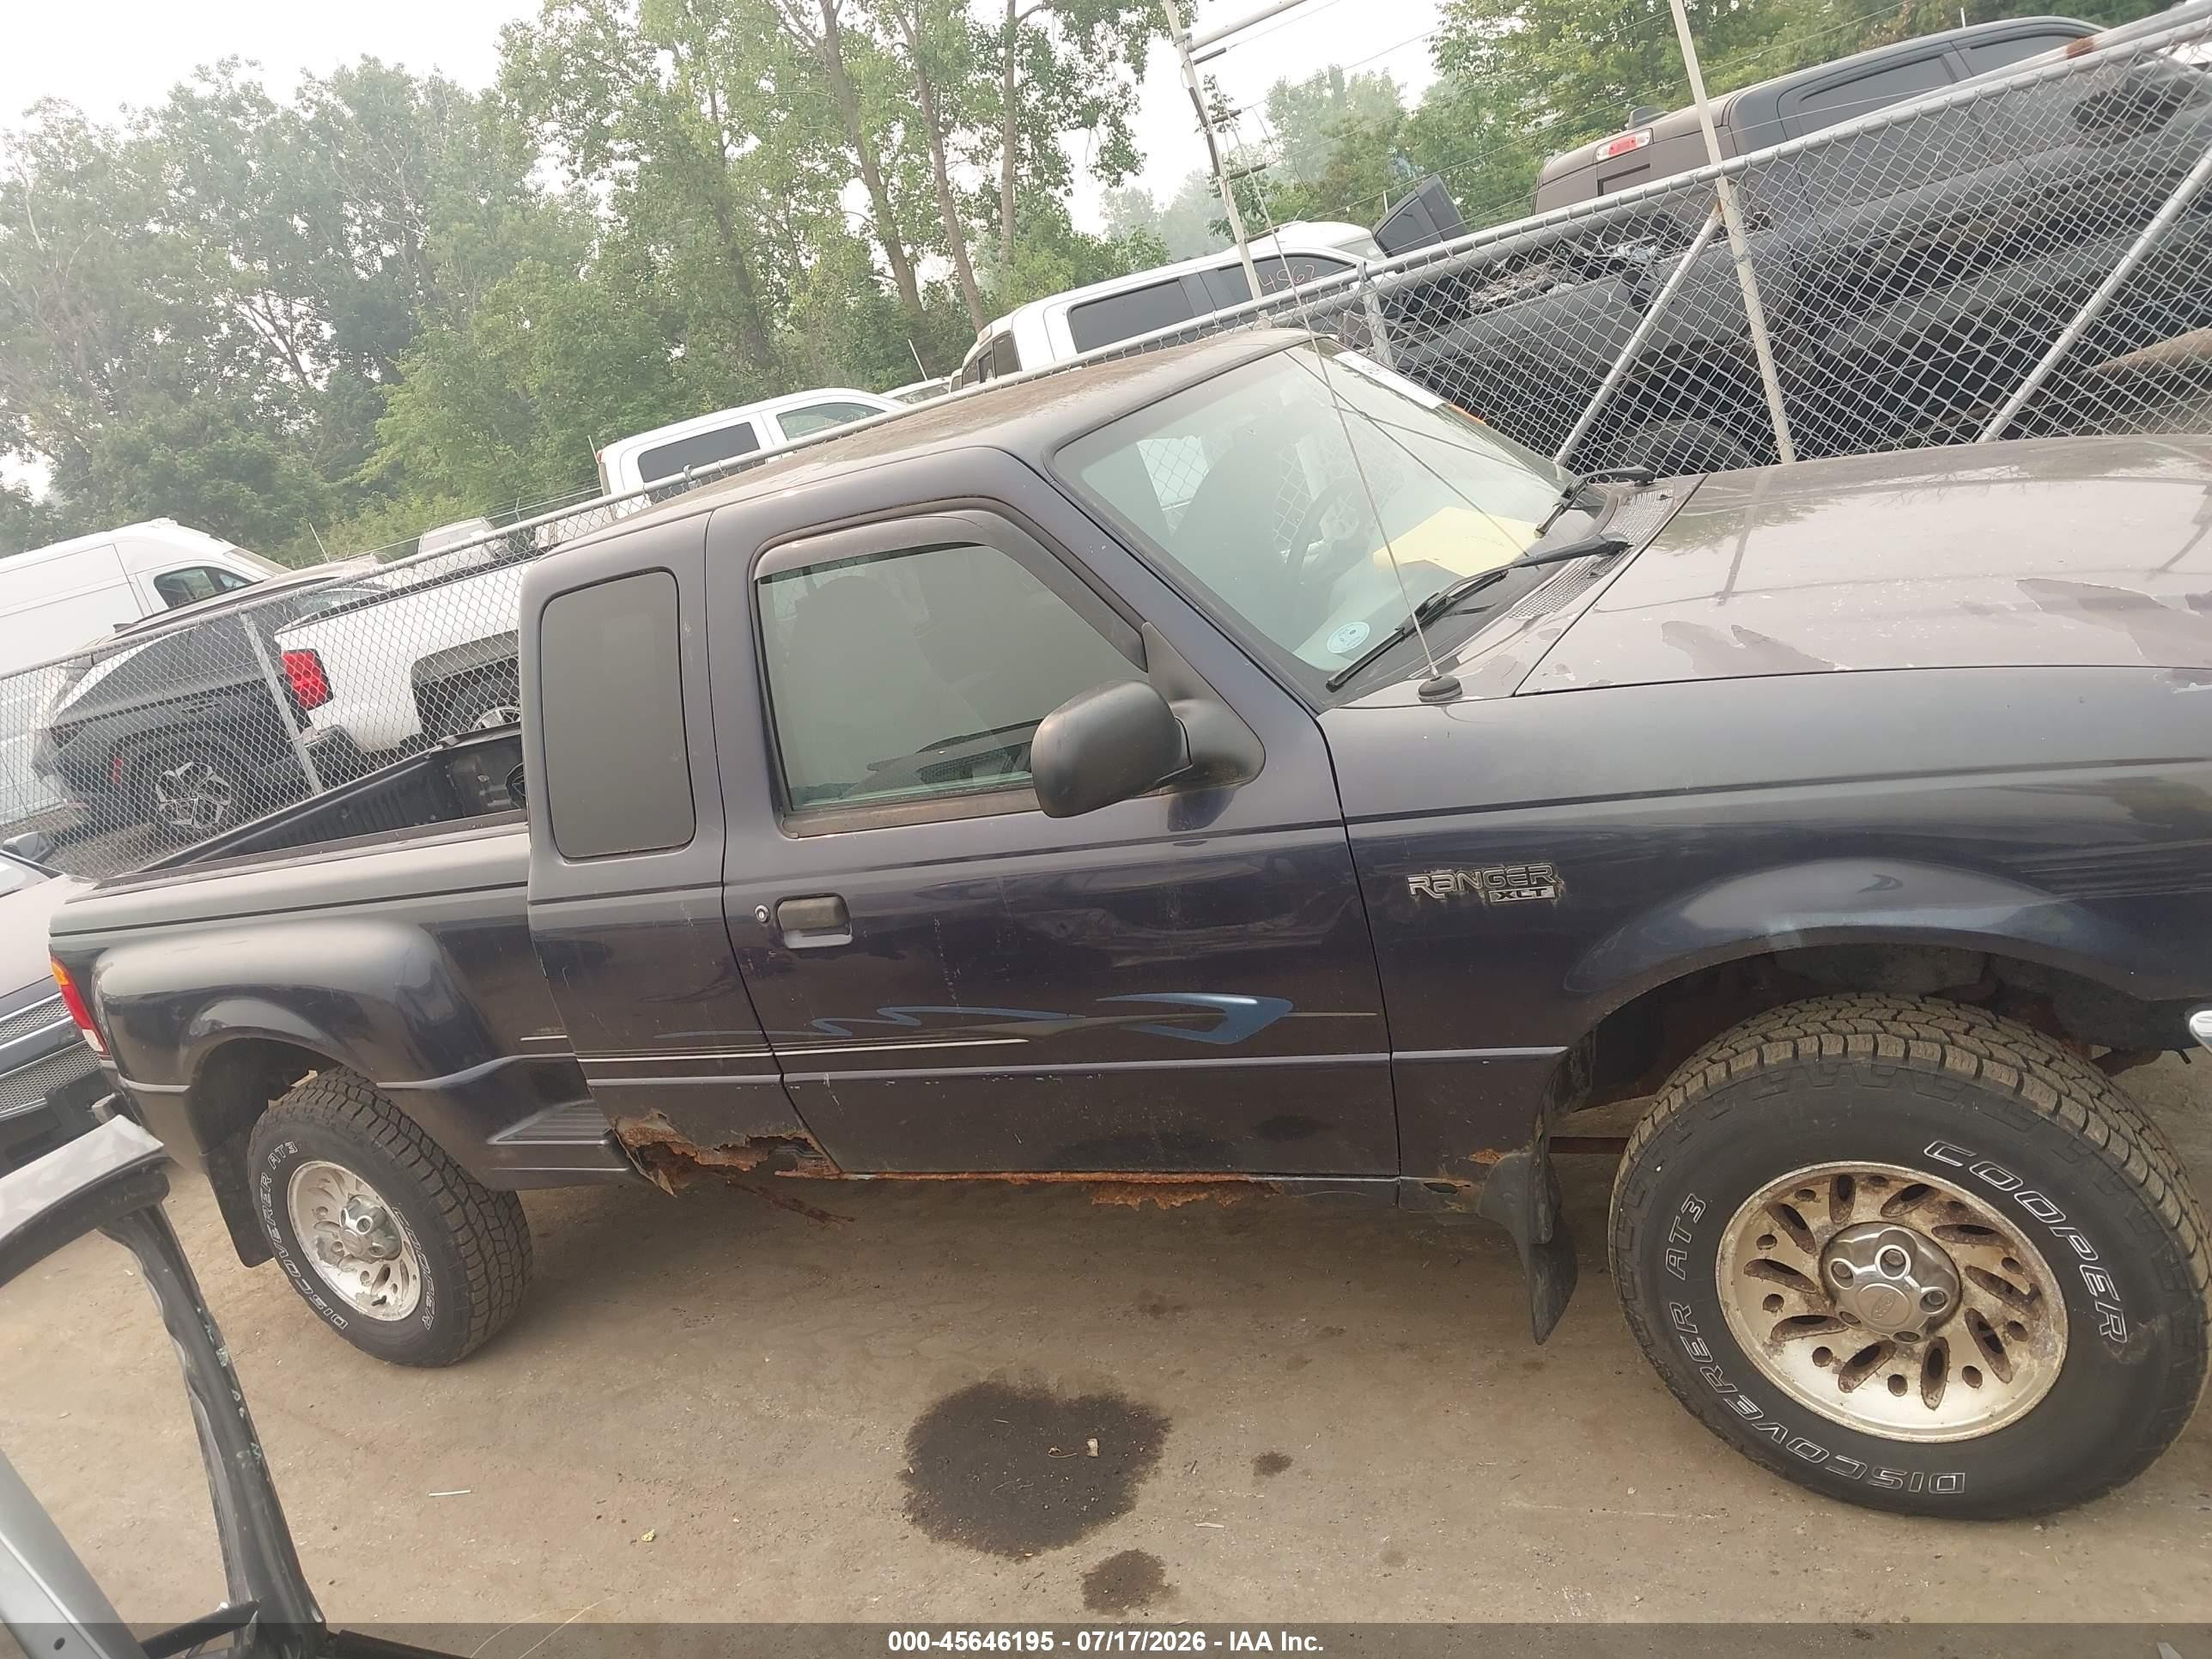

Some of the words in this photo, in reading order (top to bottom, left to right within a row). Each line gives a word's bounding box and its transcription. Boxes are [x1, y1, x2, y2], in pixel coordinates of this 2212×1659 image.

[1407, 864, 1558, 899] RANGER
[266, 1140, 299, 1170] AT3
[259, 1172, 349, 1330] DISCOVERER
[392, 1206, 435, 1331] COOPER
[1664, 1192, 1708, 1282] AT3
[1923, 1139, 2130, 1345] COOPER
[1668, 1300, 1966, 1495] DISCOVERER
